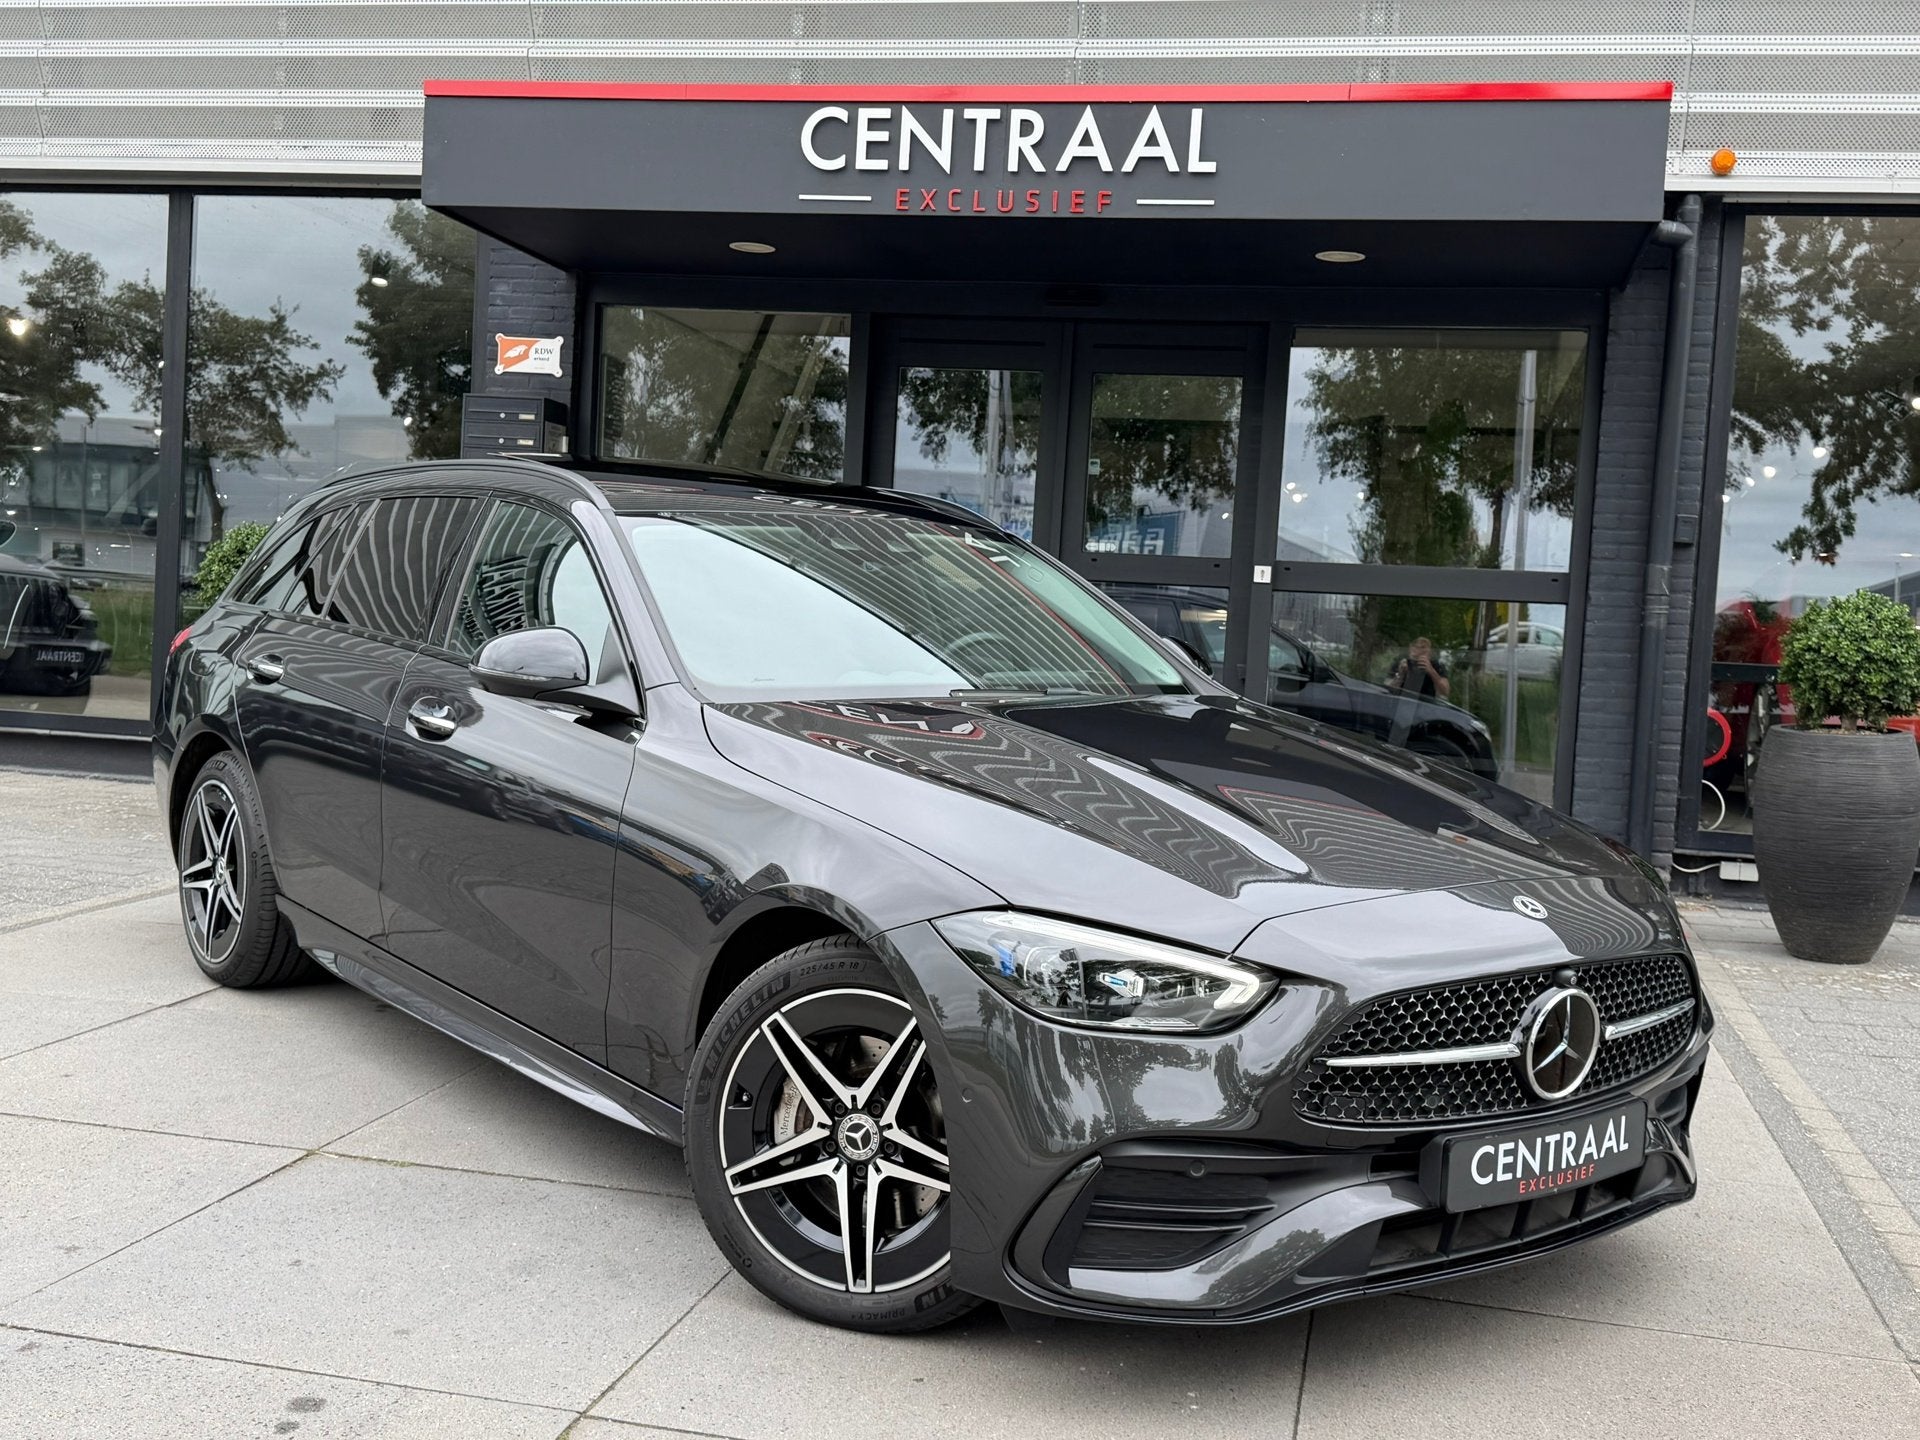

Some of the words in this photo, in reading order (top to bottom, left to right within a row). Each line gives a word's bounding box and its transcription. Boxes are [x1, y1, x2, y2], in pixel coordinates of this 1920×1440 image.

[800, 104, 1217, 175] CENTRAAL
[894, 187, 1114, 214] EXCLUSIEF
[800, 961, 836, 976] 225/45
[837, 961, 846, 969] R
[849, 961, 860, 970] 18
[704, 974, 785, 1073] MICHELIN
[1470, 1115, 1629, 1185] CENTRAAL
[1518, 1164, 1597, 1194] EXCLUSIEF
